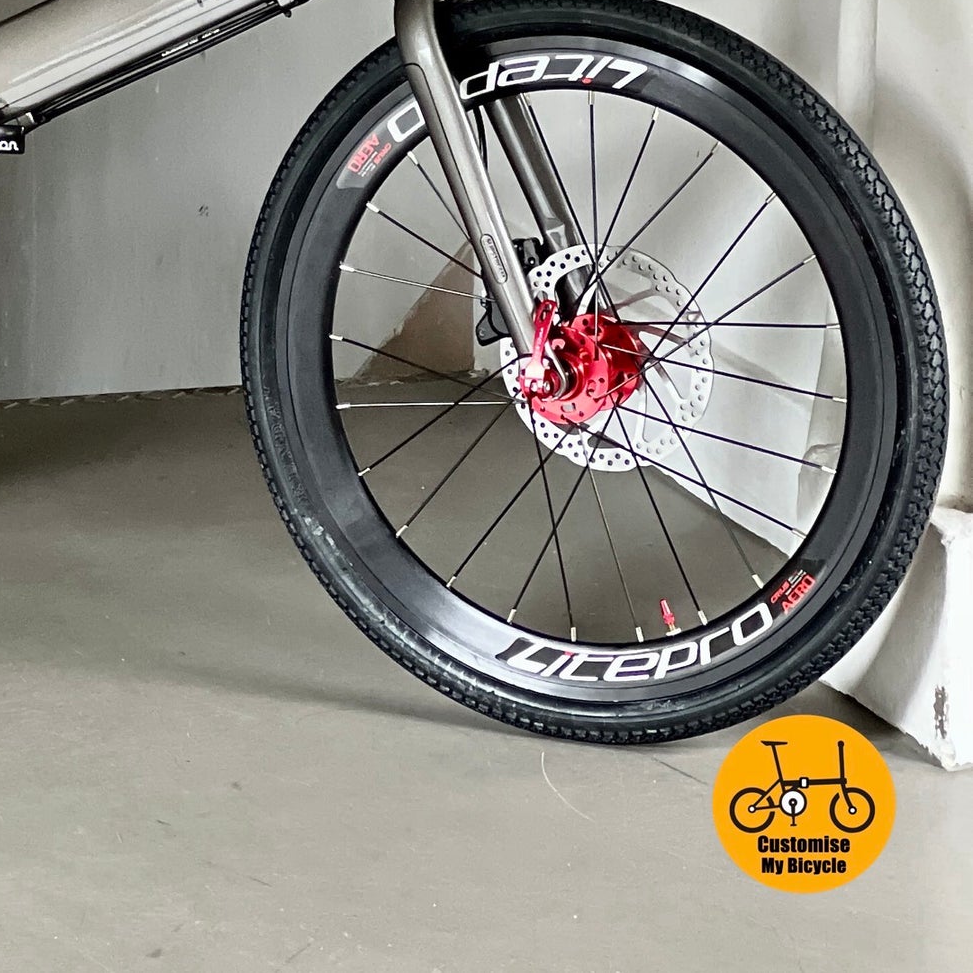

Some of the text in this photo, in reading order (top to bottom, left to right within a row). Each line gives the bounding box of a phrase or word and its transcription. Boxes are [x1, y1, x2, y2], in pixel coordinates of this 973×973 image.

[387, 54, 648, 143] Litepo
[782, 574, 816, 615] AERO
[507, 601, 773, 683] Litepro
